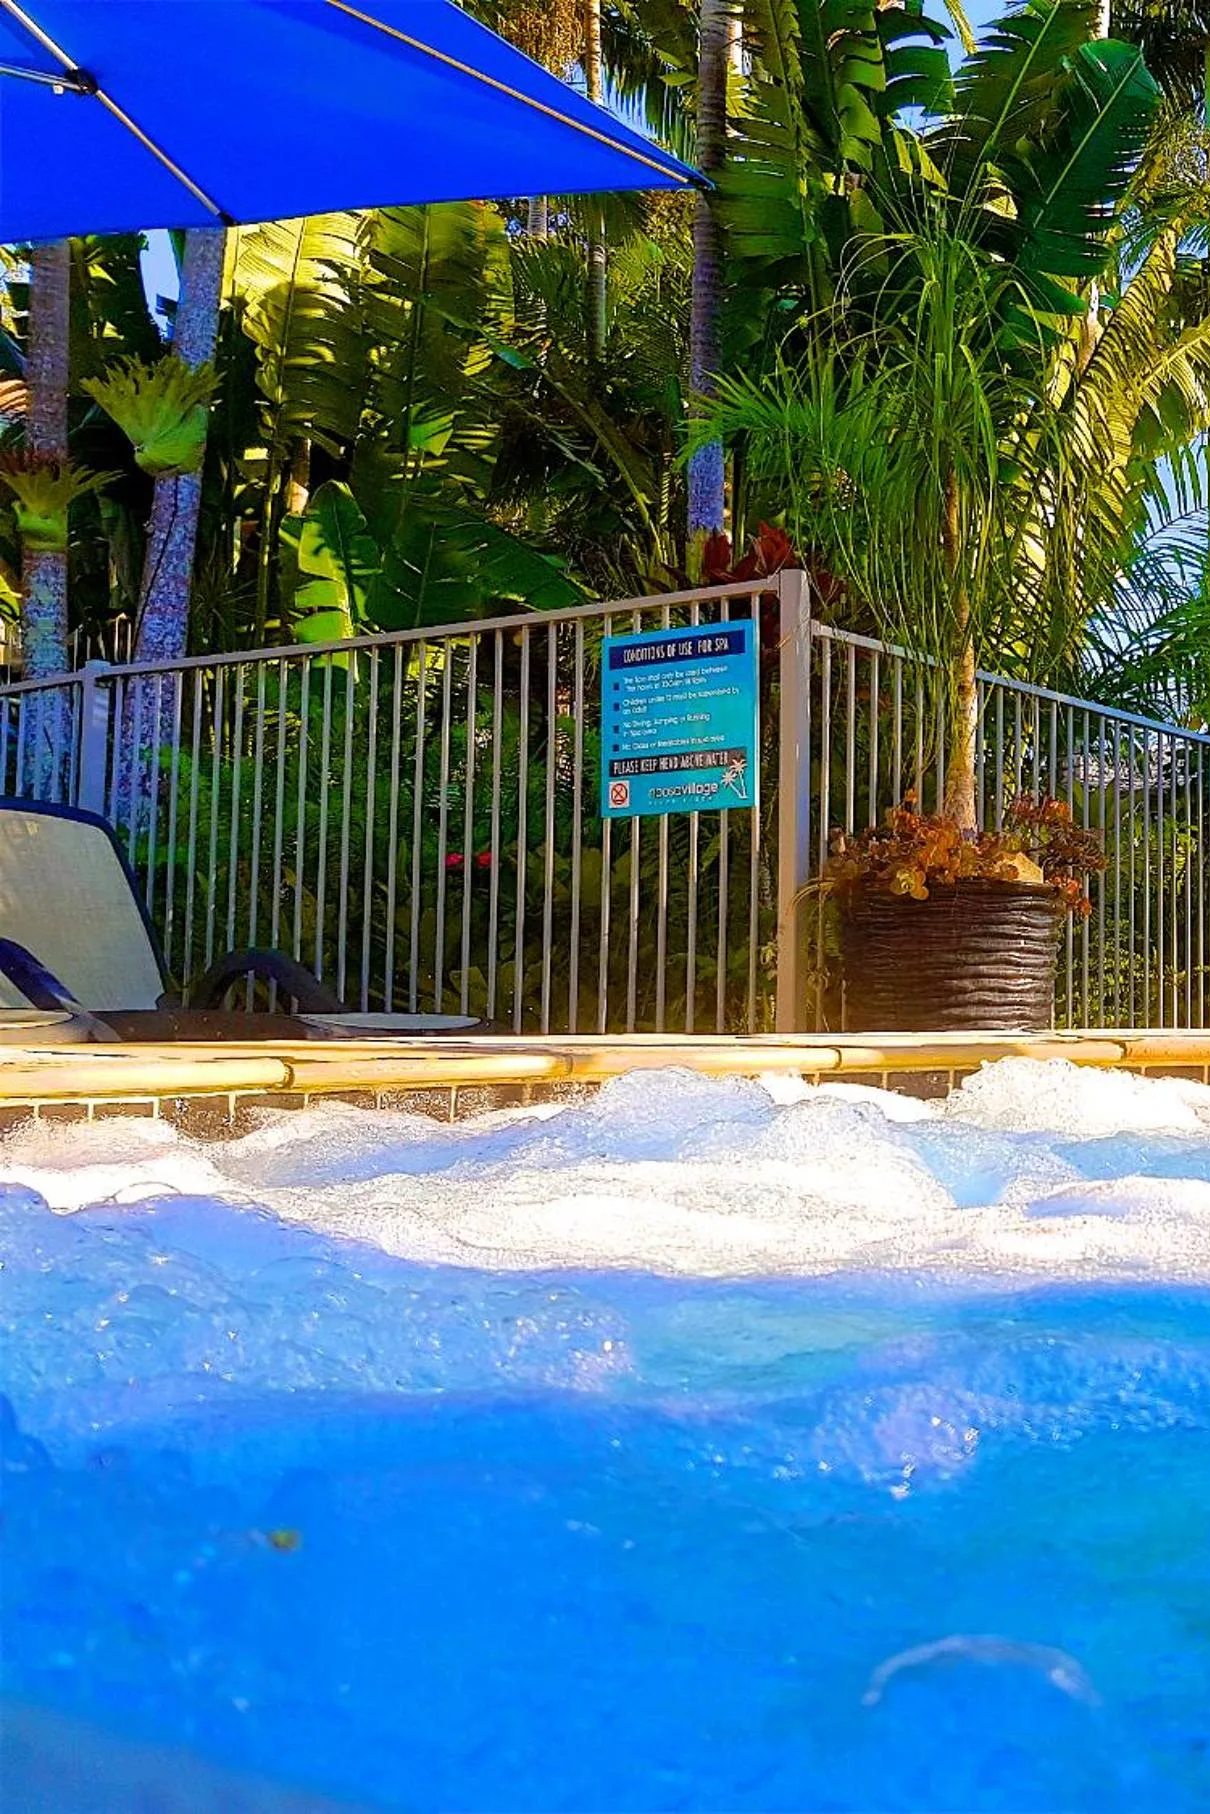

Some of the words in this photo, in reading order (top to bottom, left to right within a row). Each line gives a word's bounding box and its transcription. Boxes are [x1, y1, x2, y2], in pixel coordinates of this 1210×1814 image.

[623, 645, 665, 663] CONDITIONS
[667, 643, 676, 657] OF
[678, 641, 692, 656] USE
[697, 639, 712, 654] FOR
[715, 637, 728, 652] SPA
[731, 686, 739, 696] by
[613, 760, 639, 775] PLEASE
[640, 758, 658, 772] KEEP
[659, 755, 679, 771] HEAD
[680, 752, 703, 769] ABOVE
[706, 751, 728, 766] WATER
